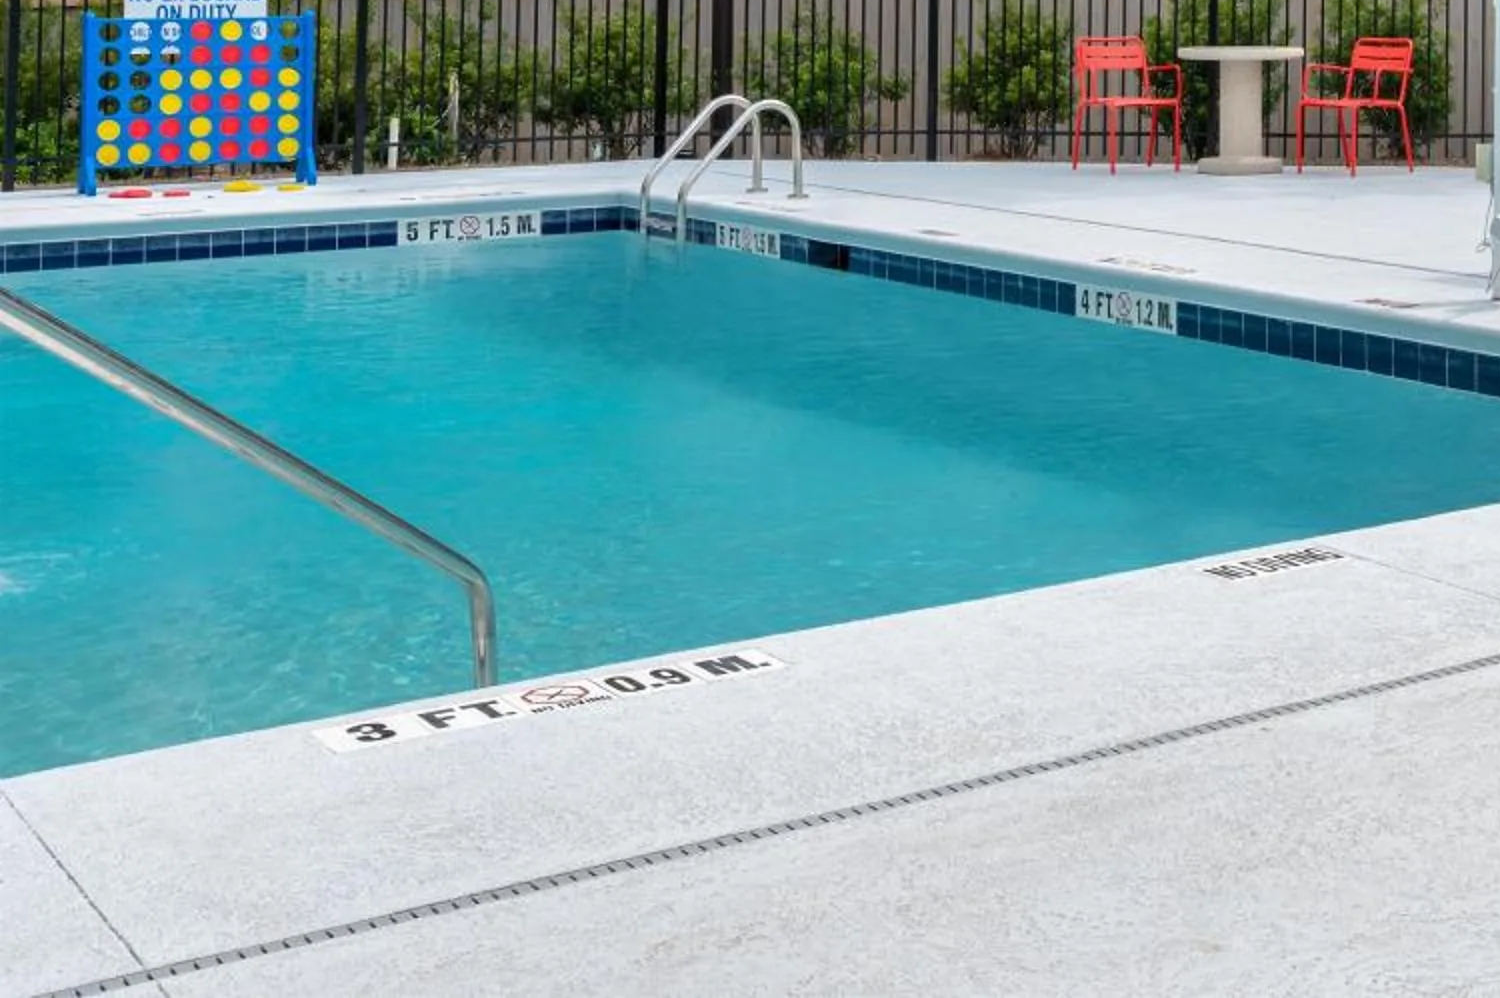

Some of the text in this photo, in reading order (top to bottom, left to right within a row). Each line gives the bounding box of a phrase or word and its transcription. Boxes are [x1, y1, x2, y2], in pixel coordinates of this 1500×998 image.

[156, 3, 238, 19] ON DUTY
[406, 221, 419, 241] 5
[486, 215, 511, 237] 1.5
[516, 213, 537, 235] M.
[1081, 289, 1089, 314] 4
[1157, 301, 1173, 331] M.
[346, 655, 773, 742] 3 FT. 0.9 M.
